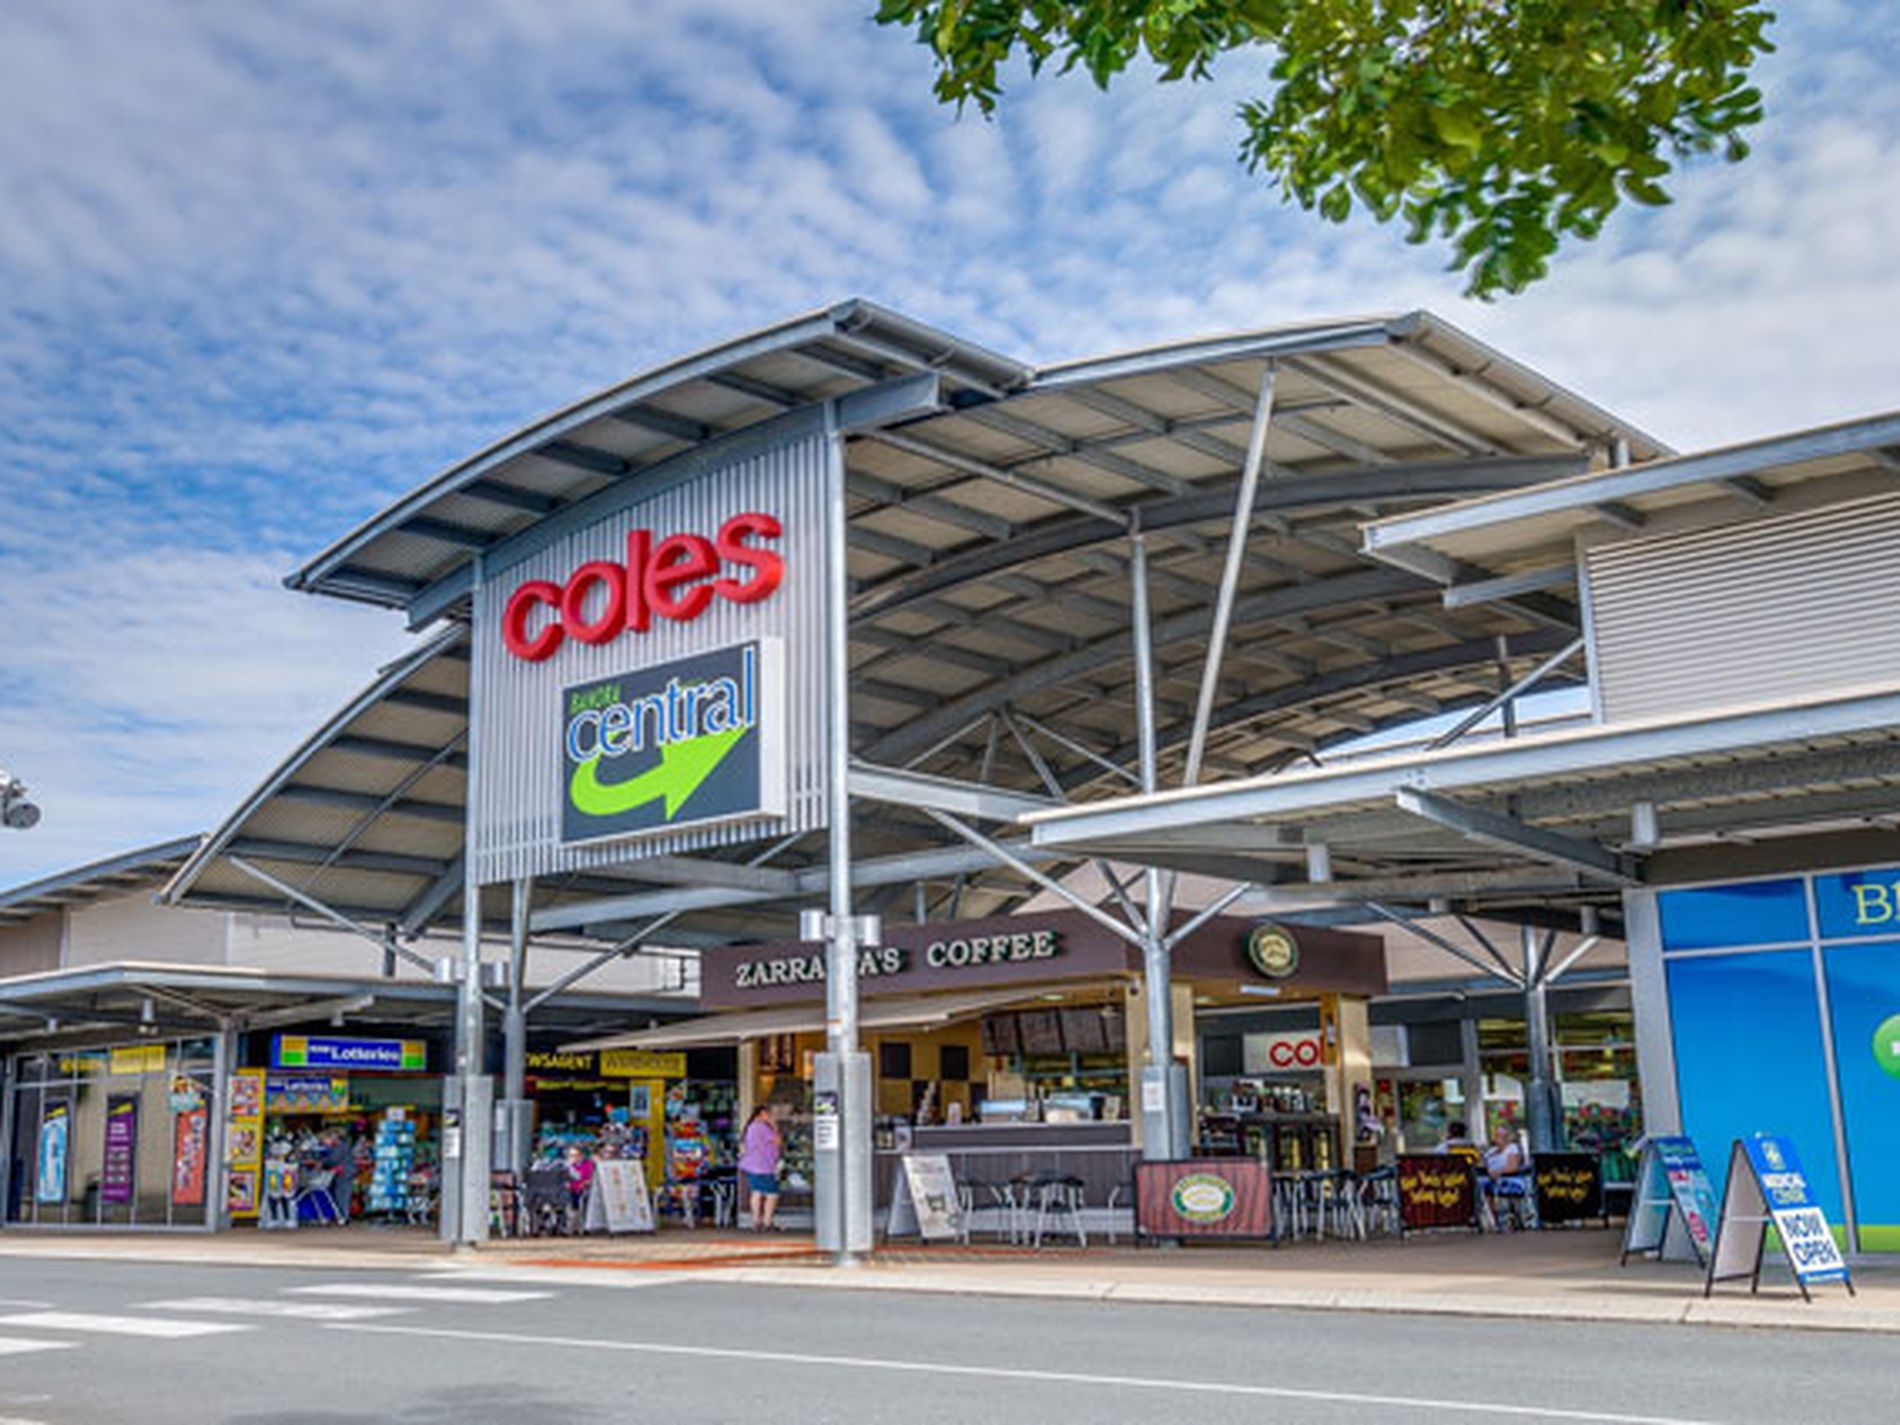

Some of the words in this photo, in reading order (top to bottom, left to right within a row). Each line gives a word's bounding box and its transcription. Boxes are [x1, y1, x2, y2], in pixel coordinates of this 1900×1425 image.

[502, 511, 784, 664] coles
[567, 646, 755, 763] central
[736, 947, 900, 988] ZARRAA'S
[926, 930, 1055, 968] COFFEE
[331, 1045, 399, 1062] Lotteries
[1782, 1213, 1825, 1238] NOW
[1793, 1240, 1838, 1266] OPEN
